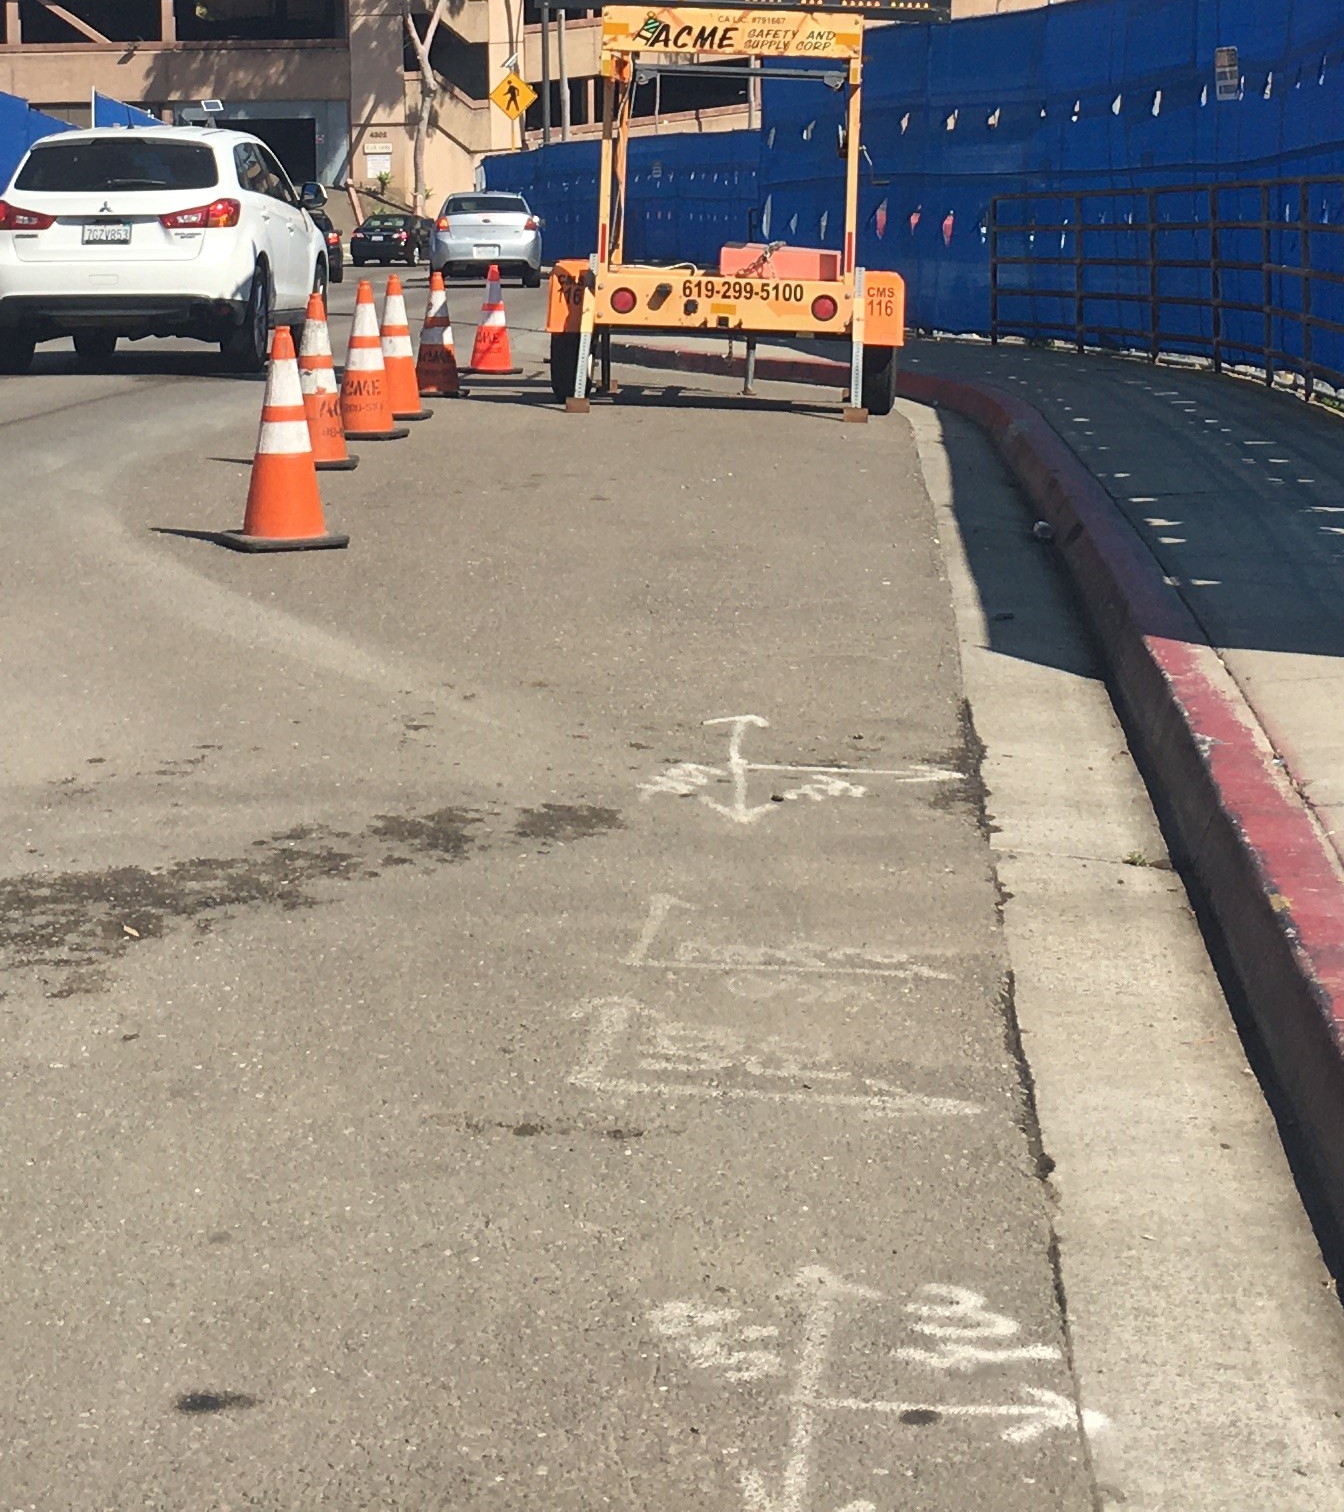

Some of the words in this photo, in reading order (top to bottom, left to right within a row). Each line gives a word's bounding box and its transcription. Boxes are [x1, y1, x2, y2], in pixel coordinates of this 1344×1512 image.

[649, 25, 739, 50] ACME
[747, 28, 800, 40] SAFETY
[806, 30, 837, 41] AND
[744, 38, 791, 50] SUPPLY
[87, 228, 128, 240] 7GZV853
[682, 279, 805, 303] 619-299-5100
[867, 287, 895, 298] CMS
[867, 299, 894, 317] 116
